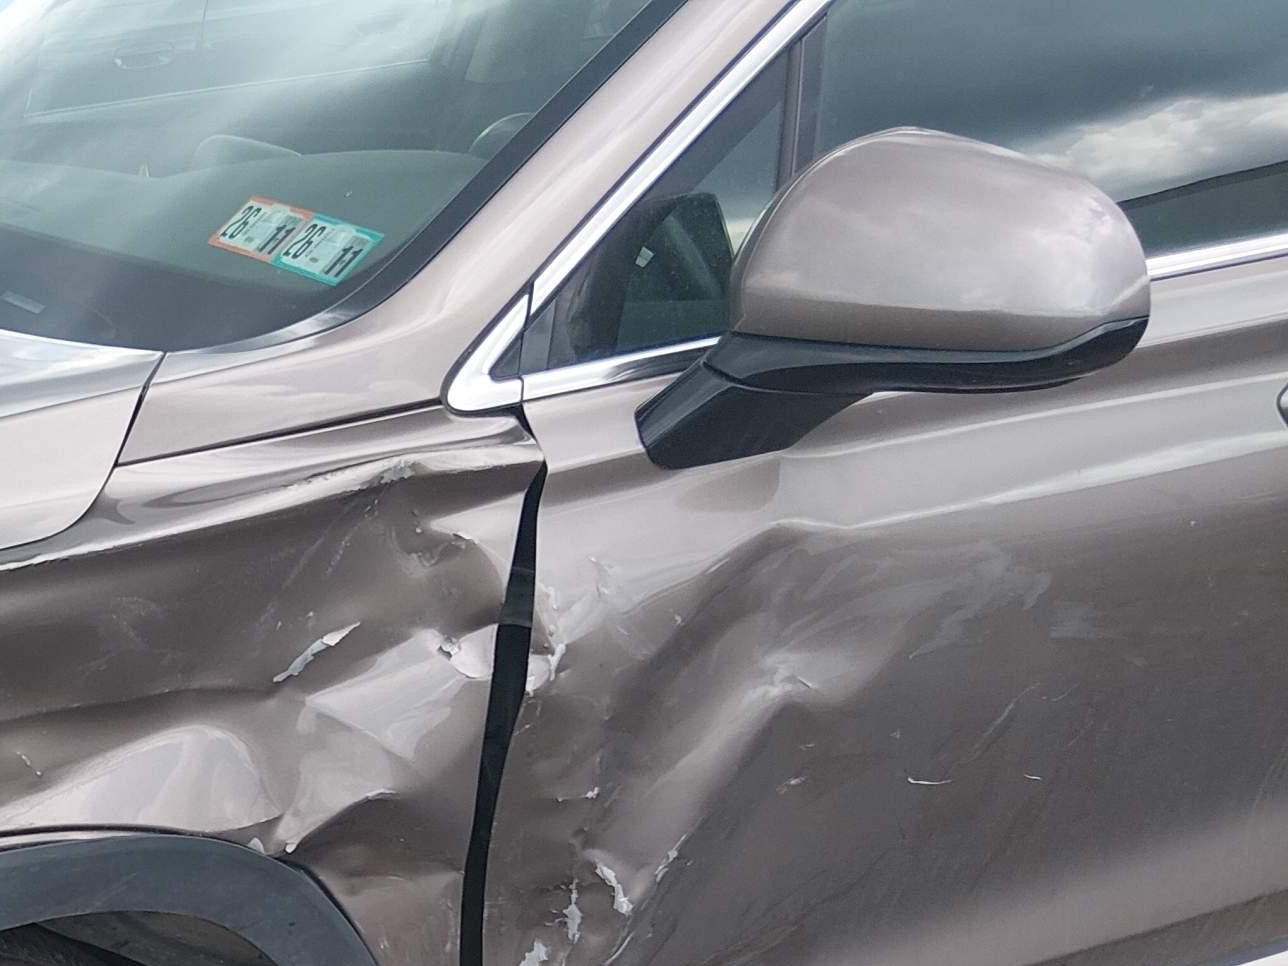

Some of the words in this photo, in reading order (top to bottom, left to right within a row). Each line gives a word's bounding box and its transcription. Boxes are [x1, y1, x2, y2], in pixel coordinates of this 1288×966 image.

[220, 205, 262, 239] 26
[258, 224, 296, 255] 11
[282, 223, 327, 259] 26
[324, 246, 363, 277] 11
